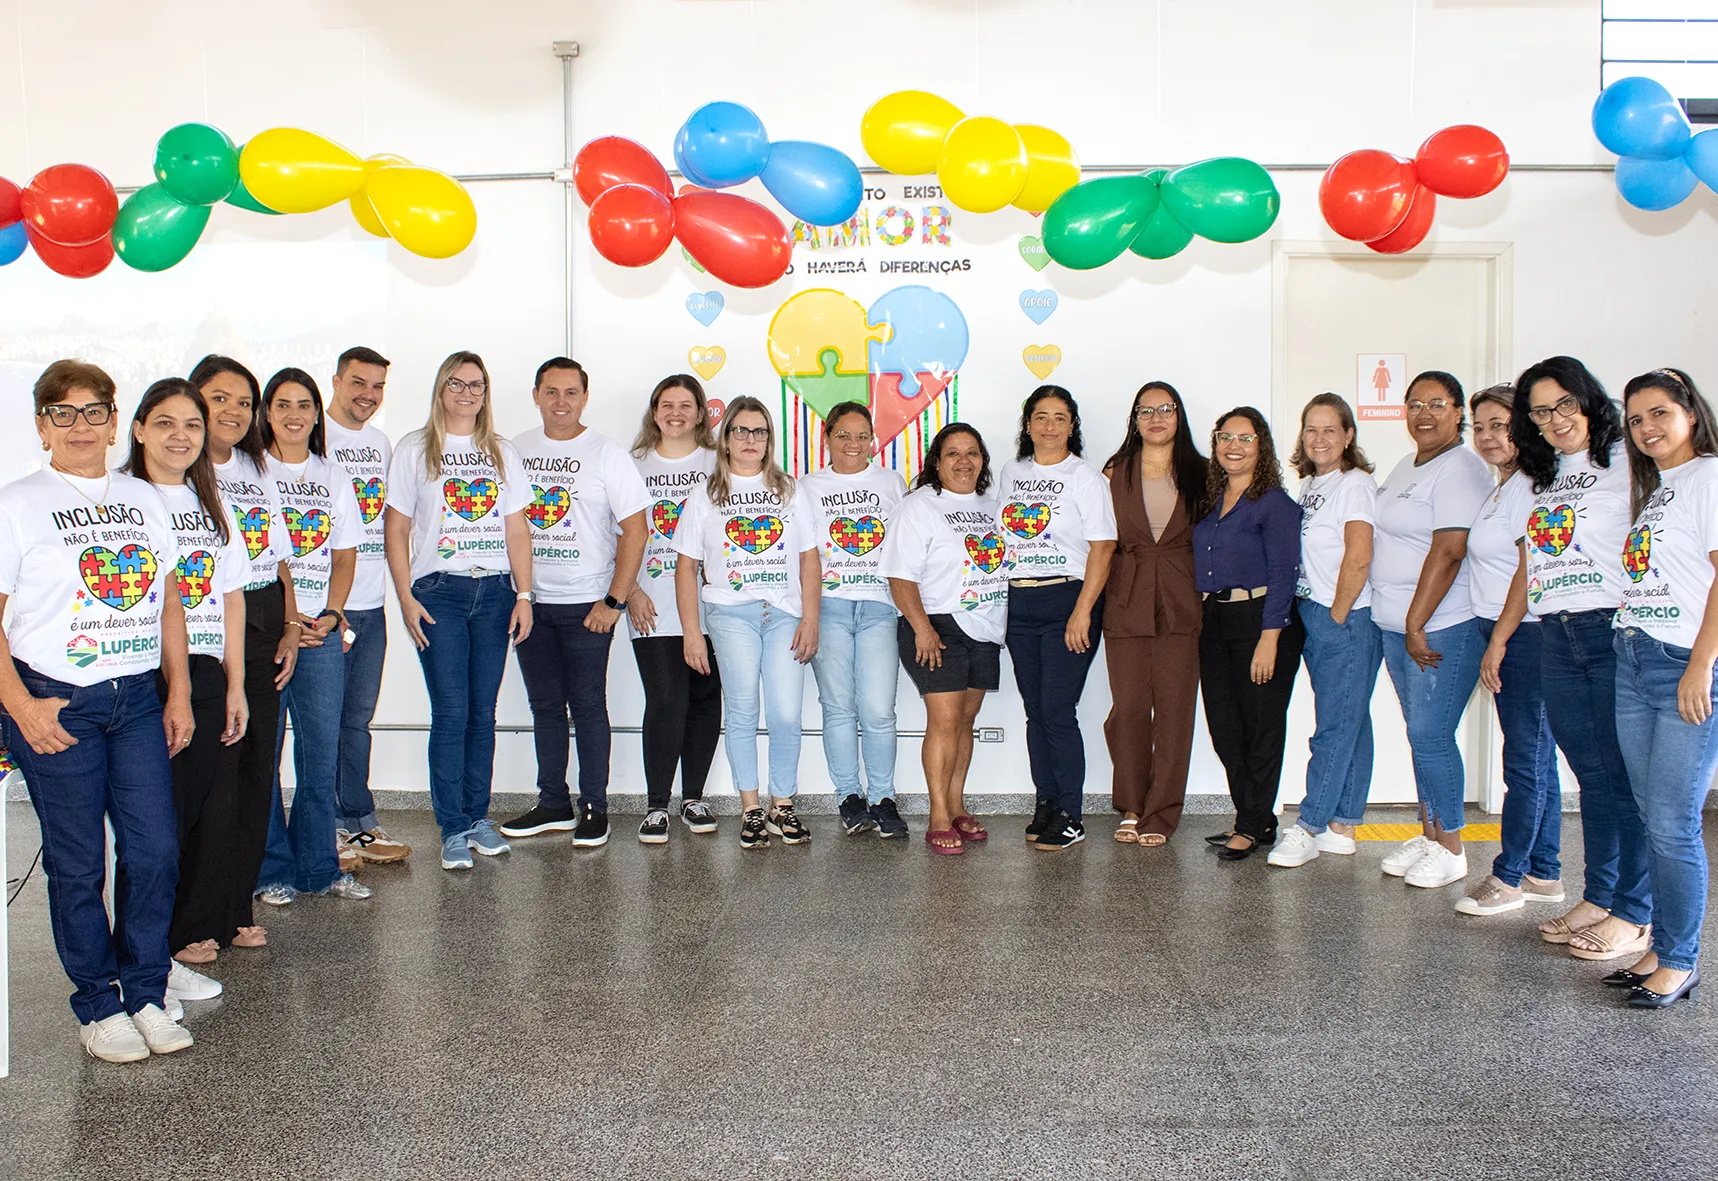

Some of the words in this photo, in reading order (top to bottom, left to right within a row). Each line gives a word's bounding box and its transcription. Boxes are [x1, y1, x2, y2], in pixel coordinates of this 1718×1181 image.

[904, 186, 943, 199] EXIST
[1021, 246, 1046, 255] CORA
[807, 258, 867, 274] HAVERÁ
[880, 259, 972, 275] DIFERENÇAS
[1024, 297, 1053, 308] APOIO
[708, 407, 721, 417] OR
[1363, 408, 1401, 417] FEMININO
[334, 446, 382, 463] INCLUSÃO
[440, 451, 495, 467] CLUSÃO
[522, 456, 581, 473] INCLUSÃO
[534, 473, 540, 482] É
[541, 474, 575, 485] BENEFÍCIO
[646, 471, 708, 488] INCLUSÃO
[216, 479, 264, 496] CLUSÃO
[276, 480, 330, 498] CLUSÃO
[664, 488, 669, 498] É
[671, 487, 693, 498] BENEF
[1012, 479, 1065, 494] INCLUSÃO
[719, 491, 782, 508] NCLUSÃO
[820, 489, 880, 507] INCLUSÃO
[52, 503, 145, 530] INCLUSÃO
[720, 508, 737, 516] NÃO
[738, 506, 743, 514] É
[746, 506, 782, 514] BENEFÍCIO
[841, 506, 846, 515] É
[848, 505, 883, 514] BENEFÍCIO
[171, 510, 217, 532] USÃO
[459, 523, 482, 533] dever
[63, 533, 89, 546] NÃO
[92, 529, 99, 542] É
[101, 528, 150, 542] BENEFÍCIO
[177, 535, 220, 548] BENEFÍCIO
[552, 531, 577, 541] social
[457, 538, 505, 550] LUPÉRCIO
[532, 546, 580, 559] UPÉRCIO
[743, 556, 765, 566] dever
[766, 554, 787, 565] social
[844, 557, 868, 567] dever
[292, 576, 328, 590] PÉRCI
[842, 572, 884, 584] LUPÉR
[1542, 572, 1604, 591] LUPÉRCIO
[1625, 603, 1680, 618] PÉRCIO
[70, 617, 79, 631] é
[80, 619, 102, 630] um
[104, 613, 137, 629] dever
